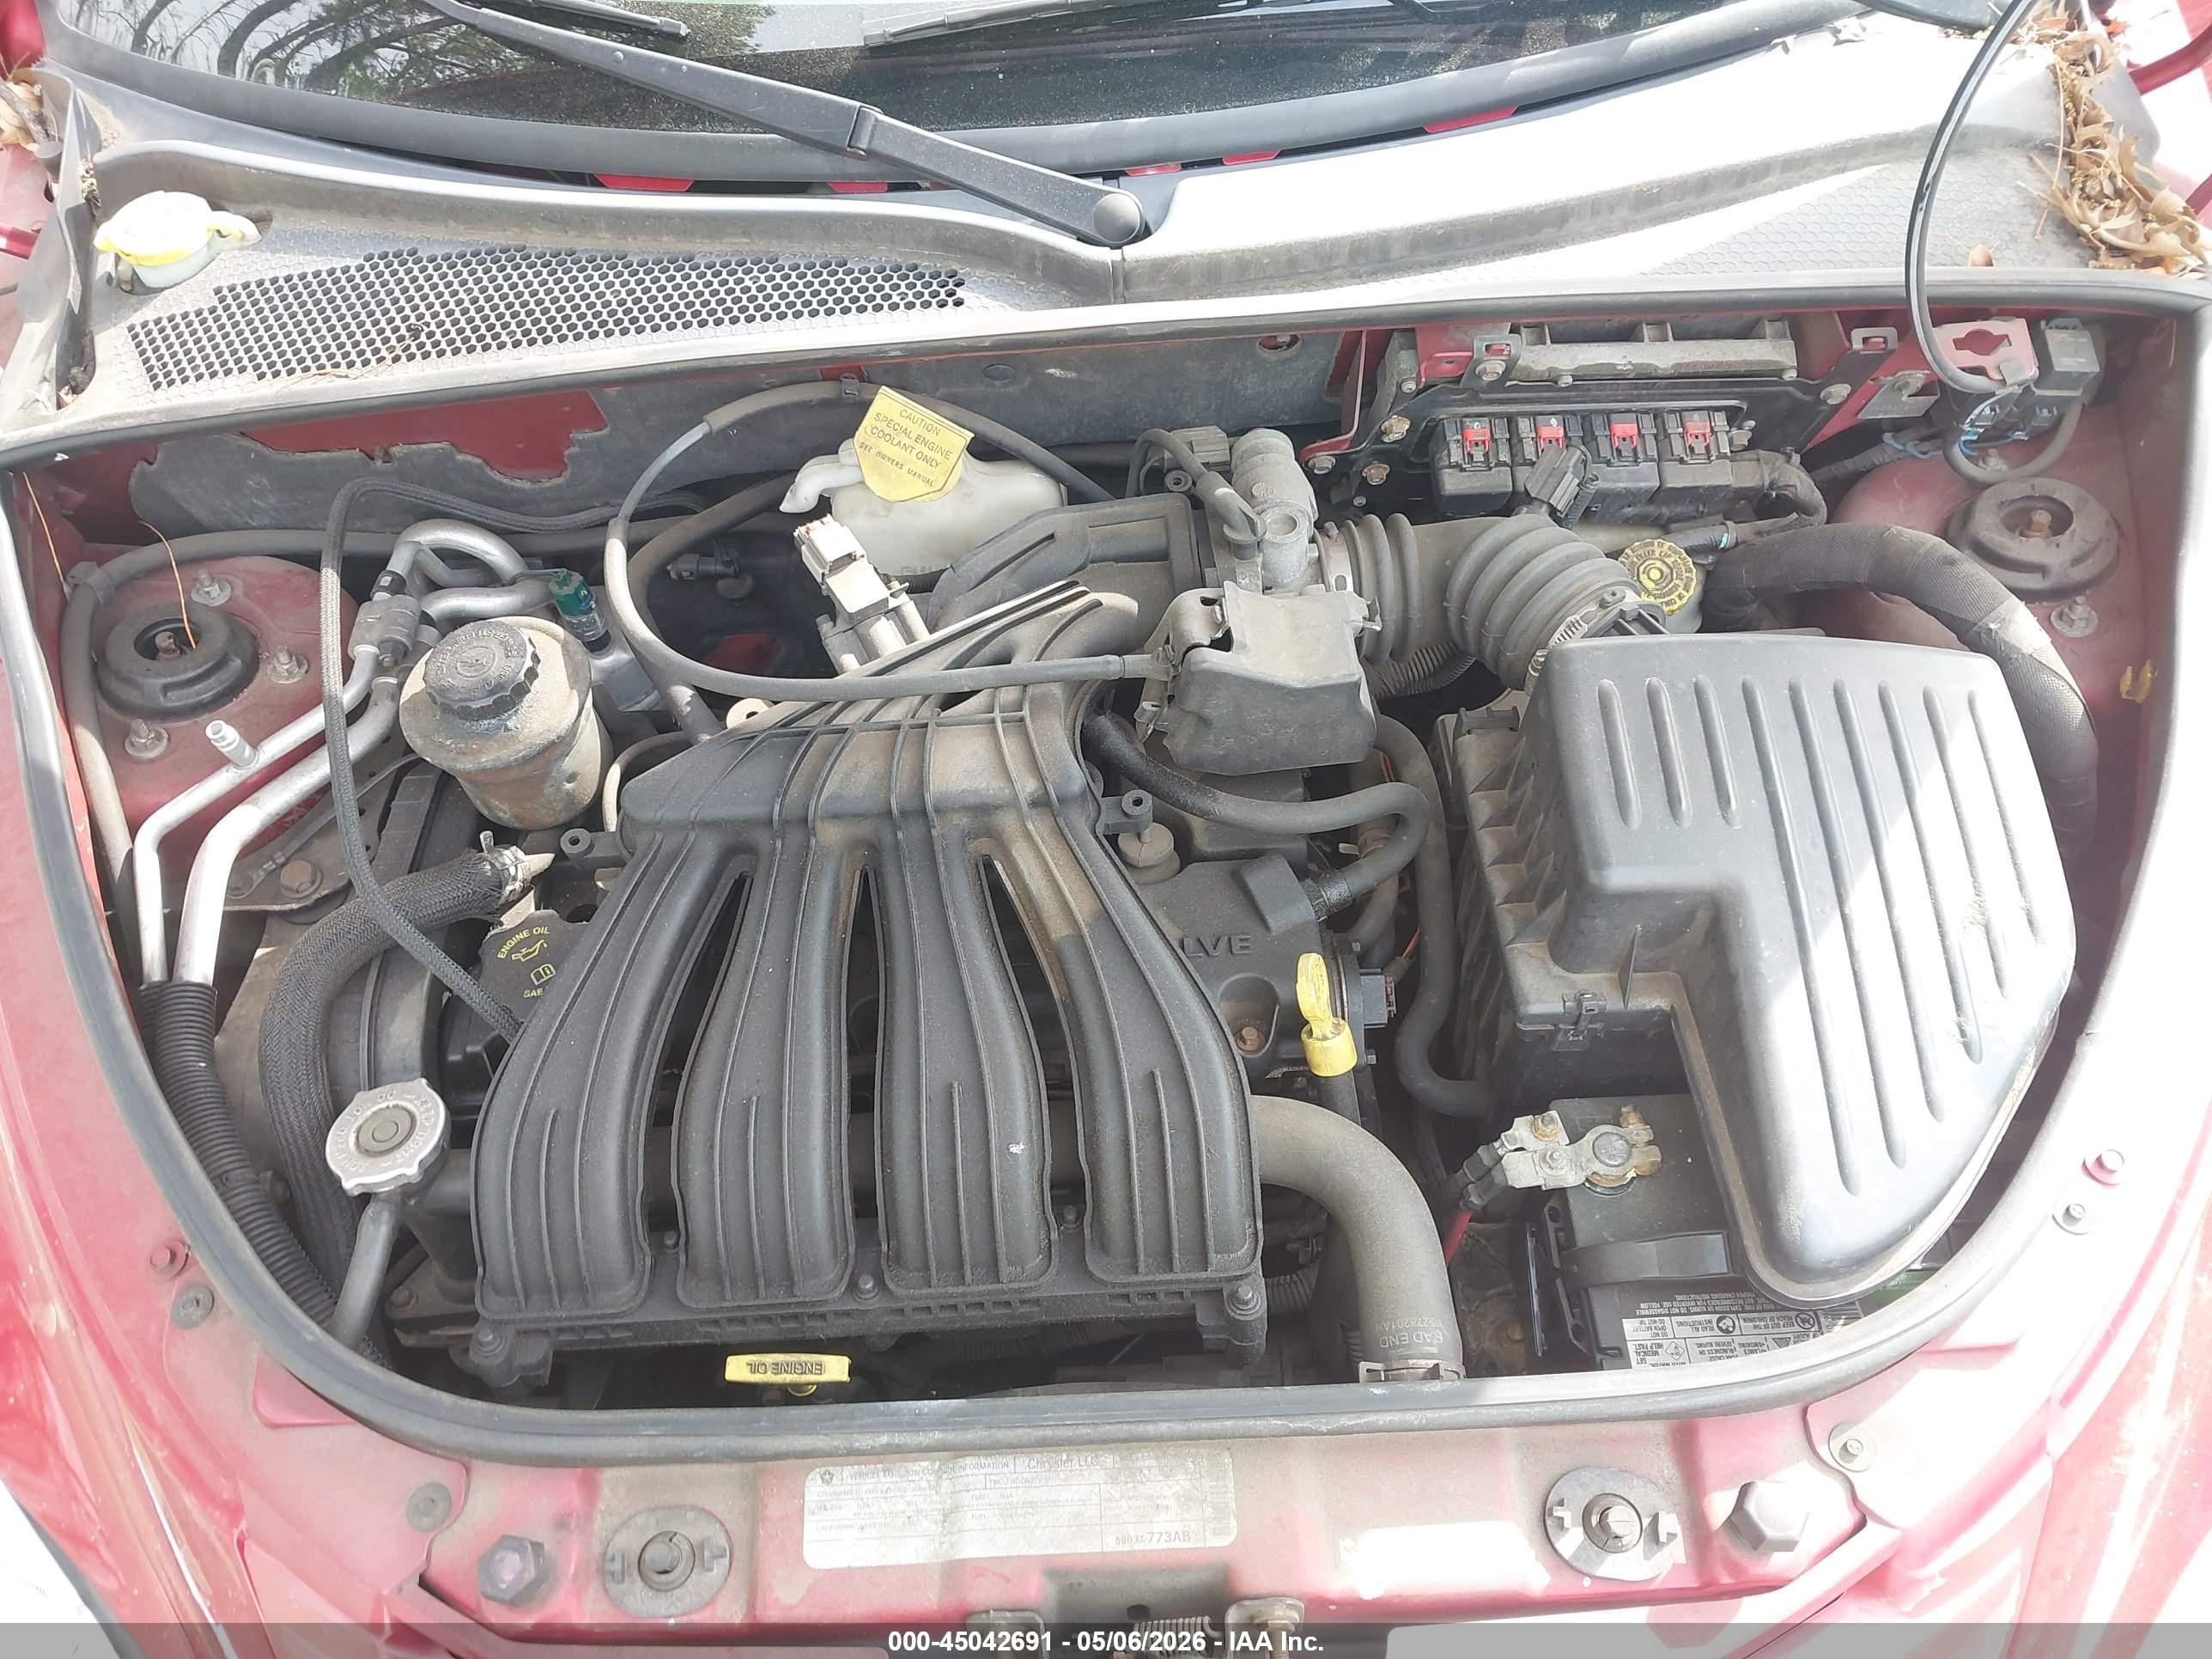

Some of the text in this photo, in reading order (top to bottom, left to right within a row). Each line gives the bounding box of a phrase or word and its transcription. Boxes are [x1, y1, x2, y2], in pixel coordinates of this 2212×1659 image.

[874, 412, 953, 460] SPECIAL ENGINE
[899, 409, 941, 436] CAUTION
[871, 426, 942, 469] COOLANT ONLY
[859, 441, 935, 487] SEE OWNERS MANUAL
[497, 929, 531, 958] ENGINE
[523, 988, 544, 998] SAE
[1379, 1332, 1409, 1348] END
[746, 1361, 824, 1375] ENGINE OIL
[1027, 1456, 1073, 1470] Chrysler
